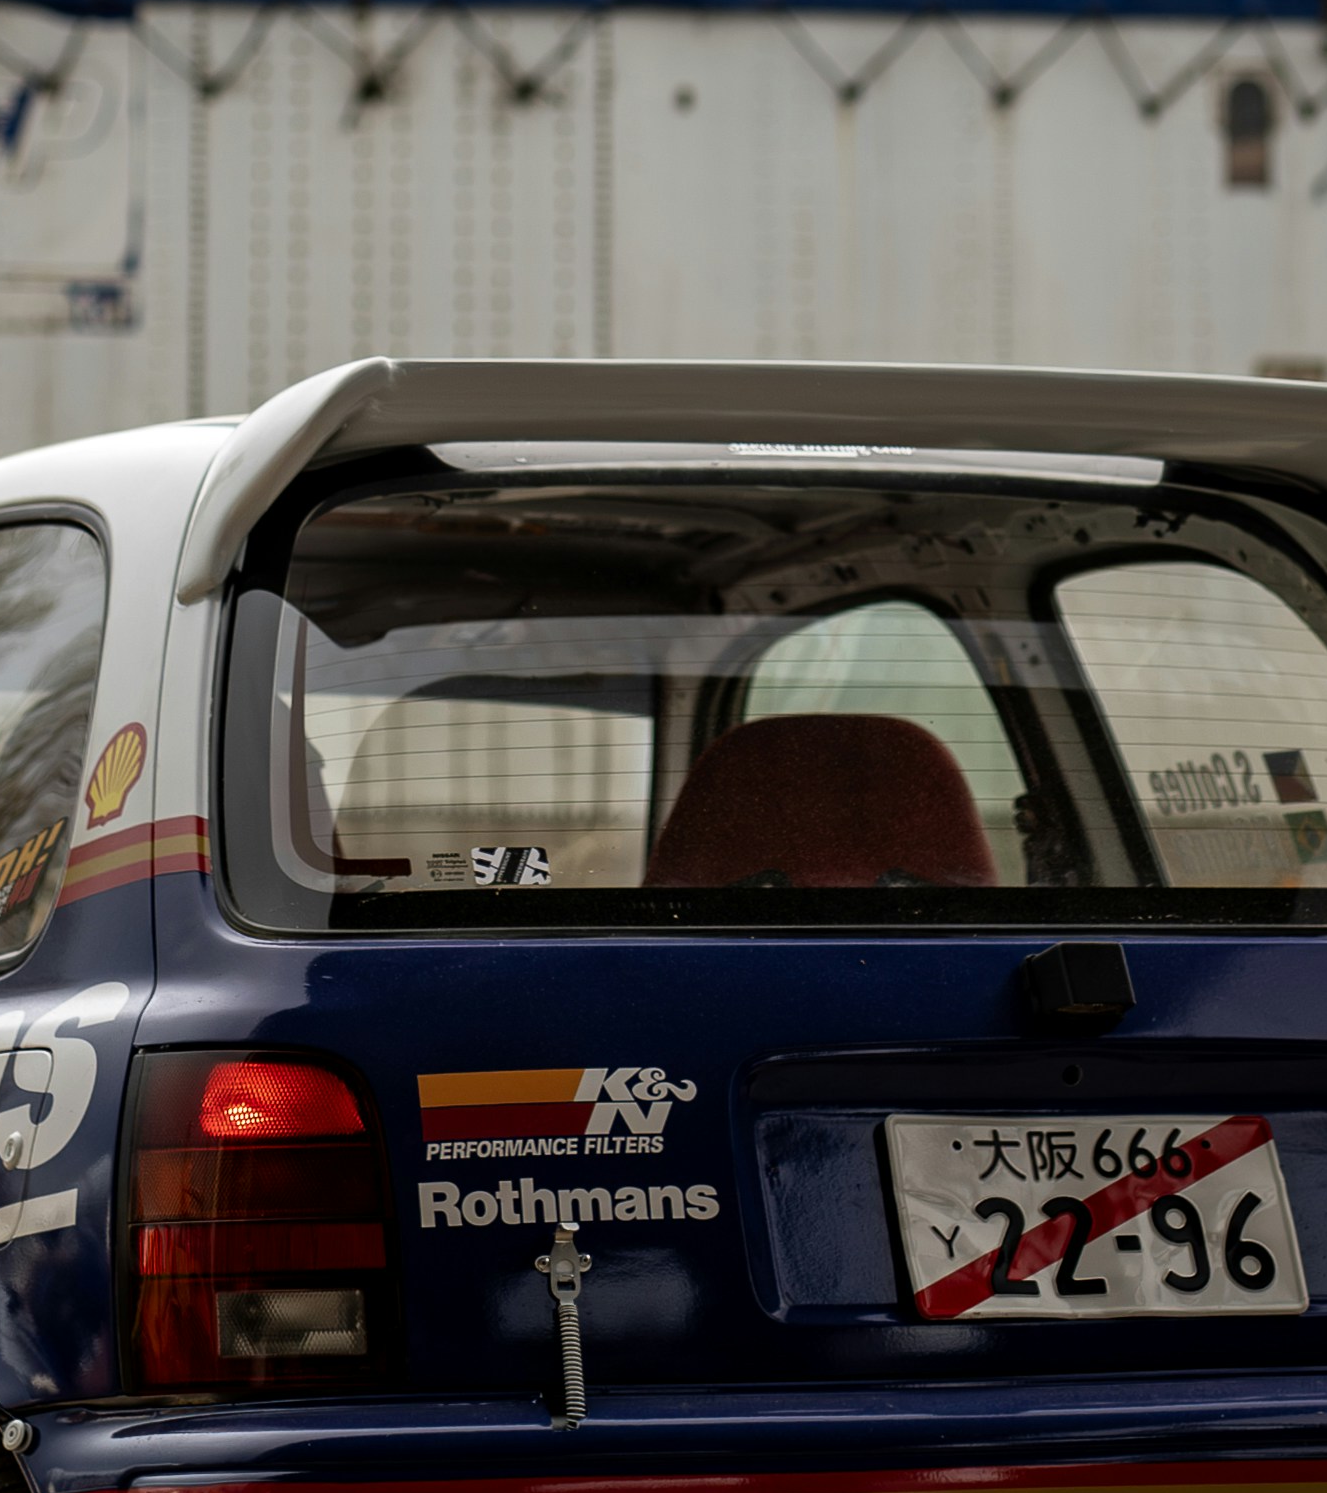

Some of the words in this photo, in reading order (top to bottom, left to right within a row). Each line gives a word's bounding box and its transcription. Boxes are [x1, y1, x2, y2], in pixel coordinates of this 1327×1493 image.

[426, 1138, 579, 1161] PERFORMANCE
[583, 1135, 665, 1157] FILTERS
[974, 1129, 1085, 1182] 大阪
[1092, 1128, 1193, 1179] 666
[418, 1178, 721, 1229] Rothmans
[931, 1225, 961, 1258] Y
[974, 1190, 1276, 1297] 22-96
